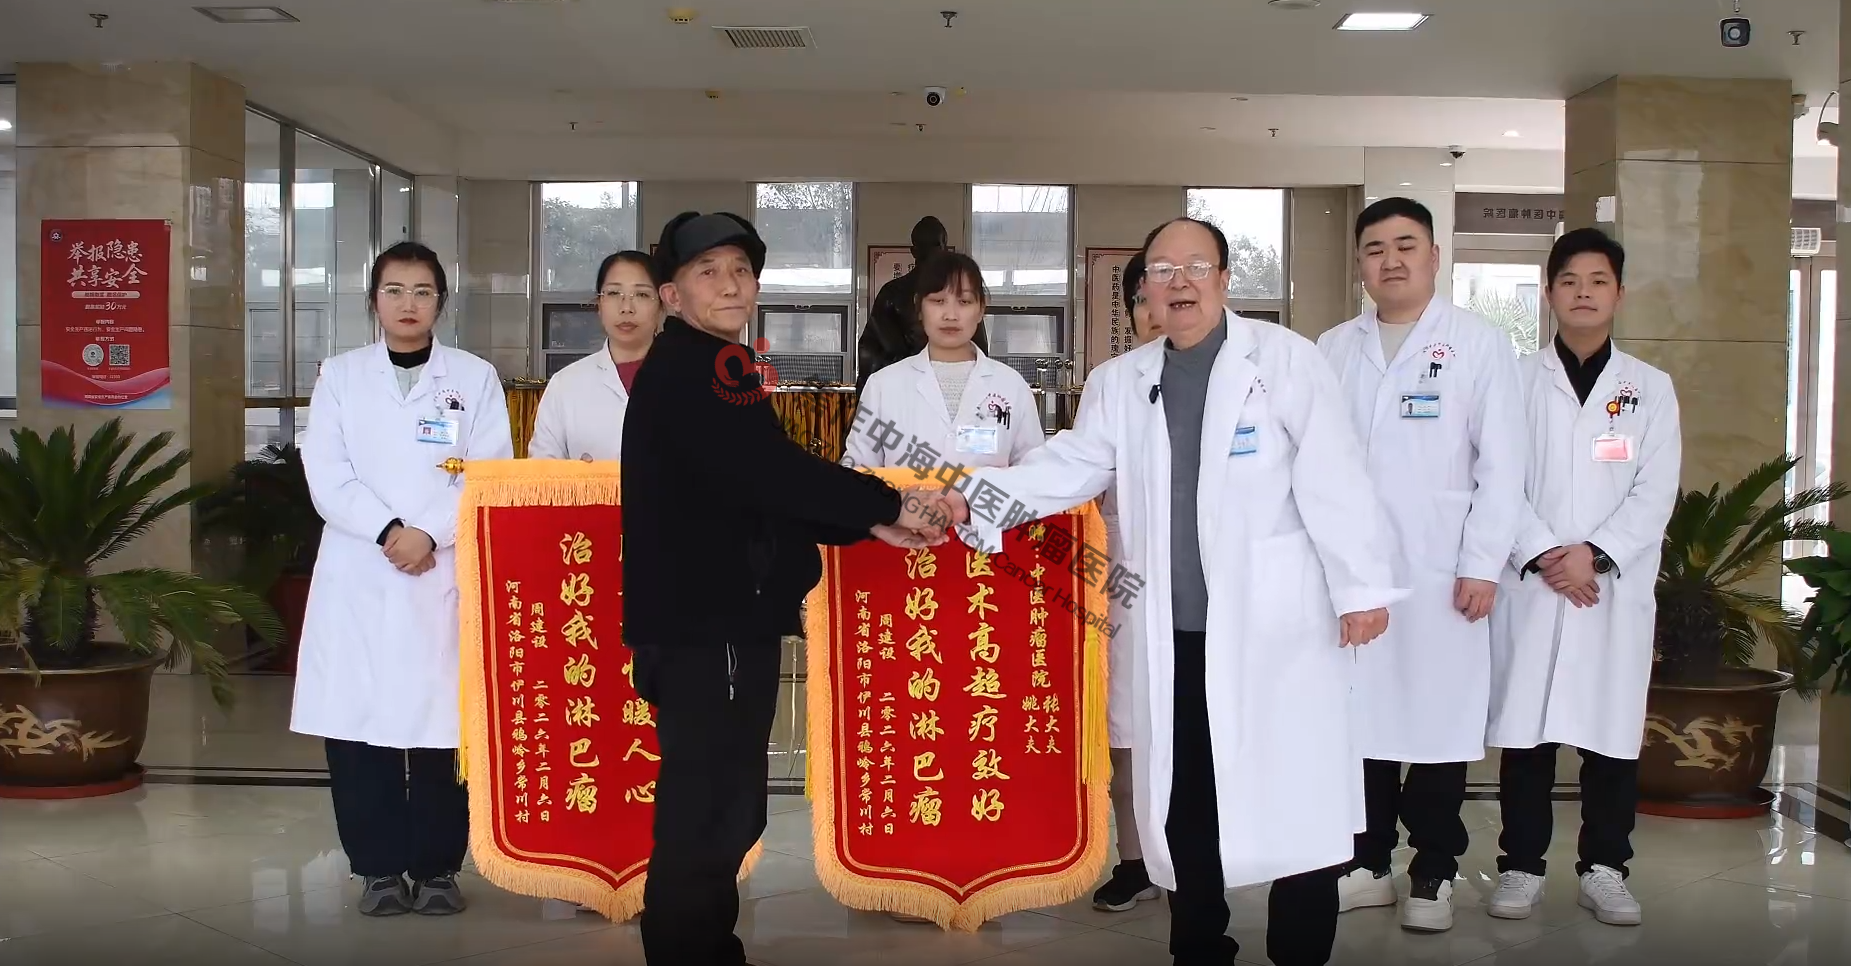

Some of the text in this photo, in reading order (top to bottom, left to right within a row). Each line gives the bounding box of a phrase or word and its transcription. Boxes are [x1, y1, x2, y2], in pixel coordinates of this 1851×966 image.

[66, 263, 148, 289] 共享安全
[67, 239, 143, 264] 举报隐患
[530, 601, 553, 823] 周建设 二零二六年二月六日
[558, 531, 601, 814] 治好我的淋巴瘤
[877, 613, 897, 836] 周建设 二零二六年二月六日
[904, 547, 946, 828] 治好我的淋巴瘤
[963, 550, 1011, 822] 医术高超疗效好
